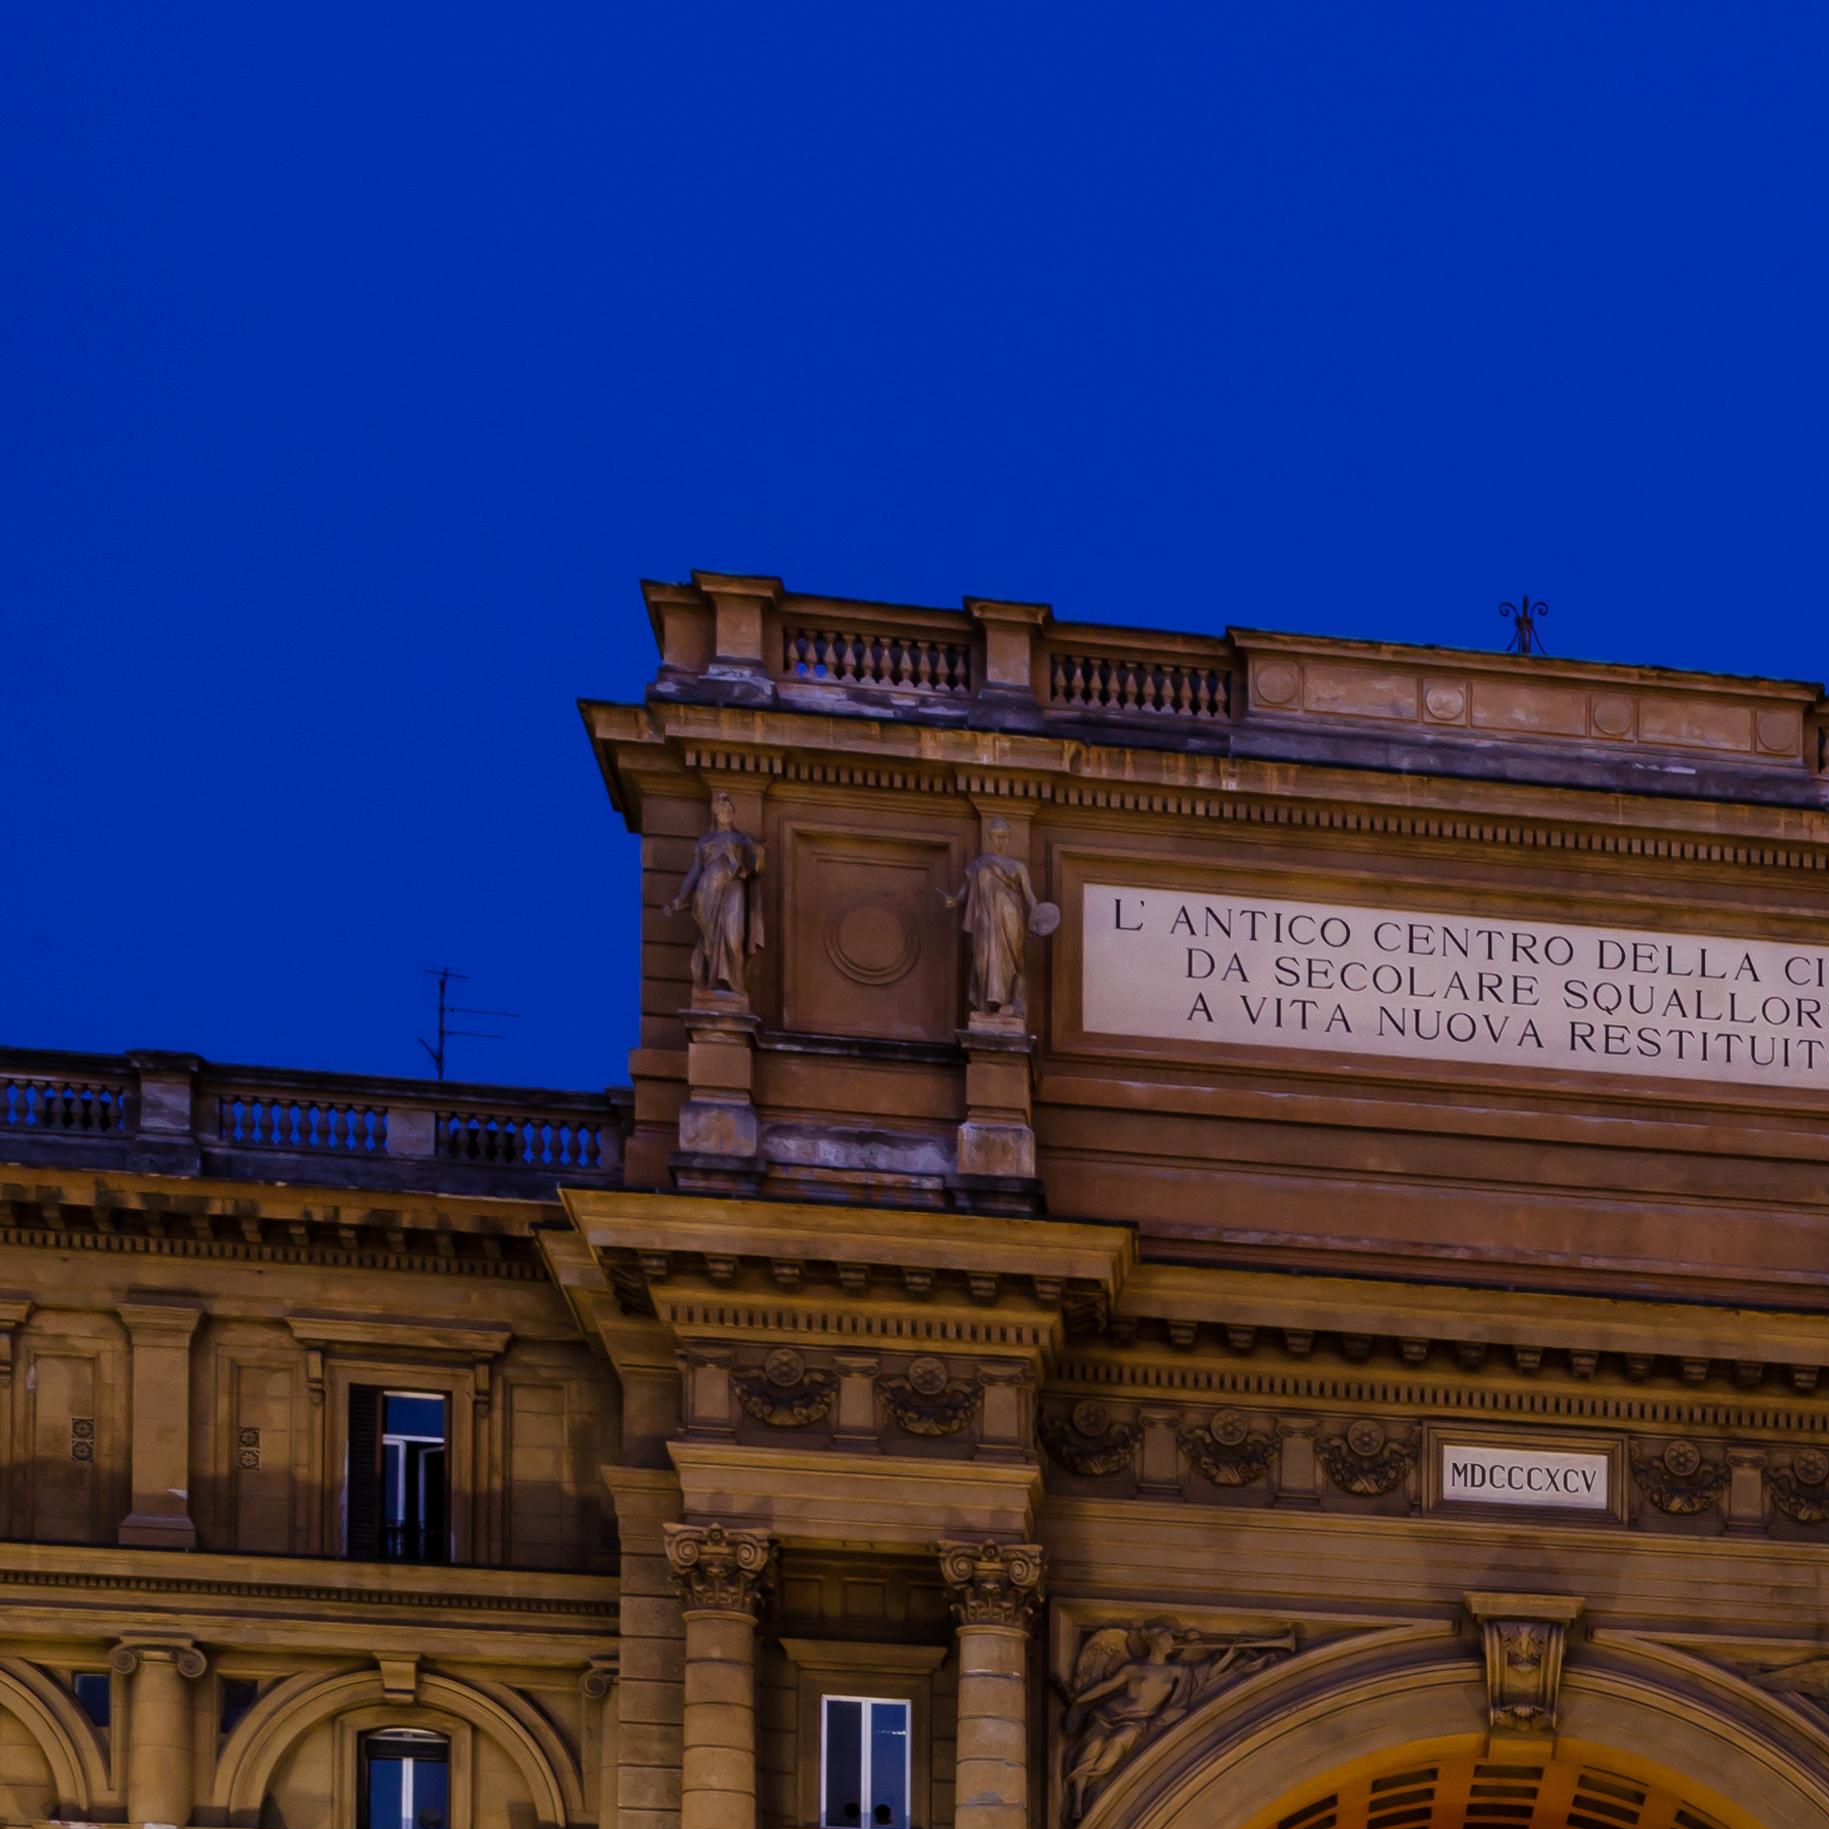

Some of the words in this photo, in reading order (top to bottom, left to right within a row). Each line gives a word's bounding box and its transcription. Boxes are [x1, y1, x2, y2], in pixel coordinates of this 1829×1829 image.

[1113, 898, 1146, 931] L'
[1170, 905, 1351, 948] ANTICO
[1373, 922, 1574, 966] CENTRO
[1597, 939, 1760, 983] DELLA
[1185, 948, 1250, 983] DA
[1274, 956, 1540, 1006] SECOLARE
[1187, 992, 1215, 1023] A
[1239, 995, 1353, 1033] VITA
[1377, 1005, 1545, 1049] NUOVA
[1451, 1462, 1597, 1493] MDCCCXCV
